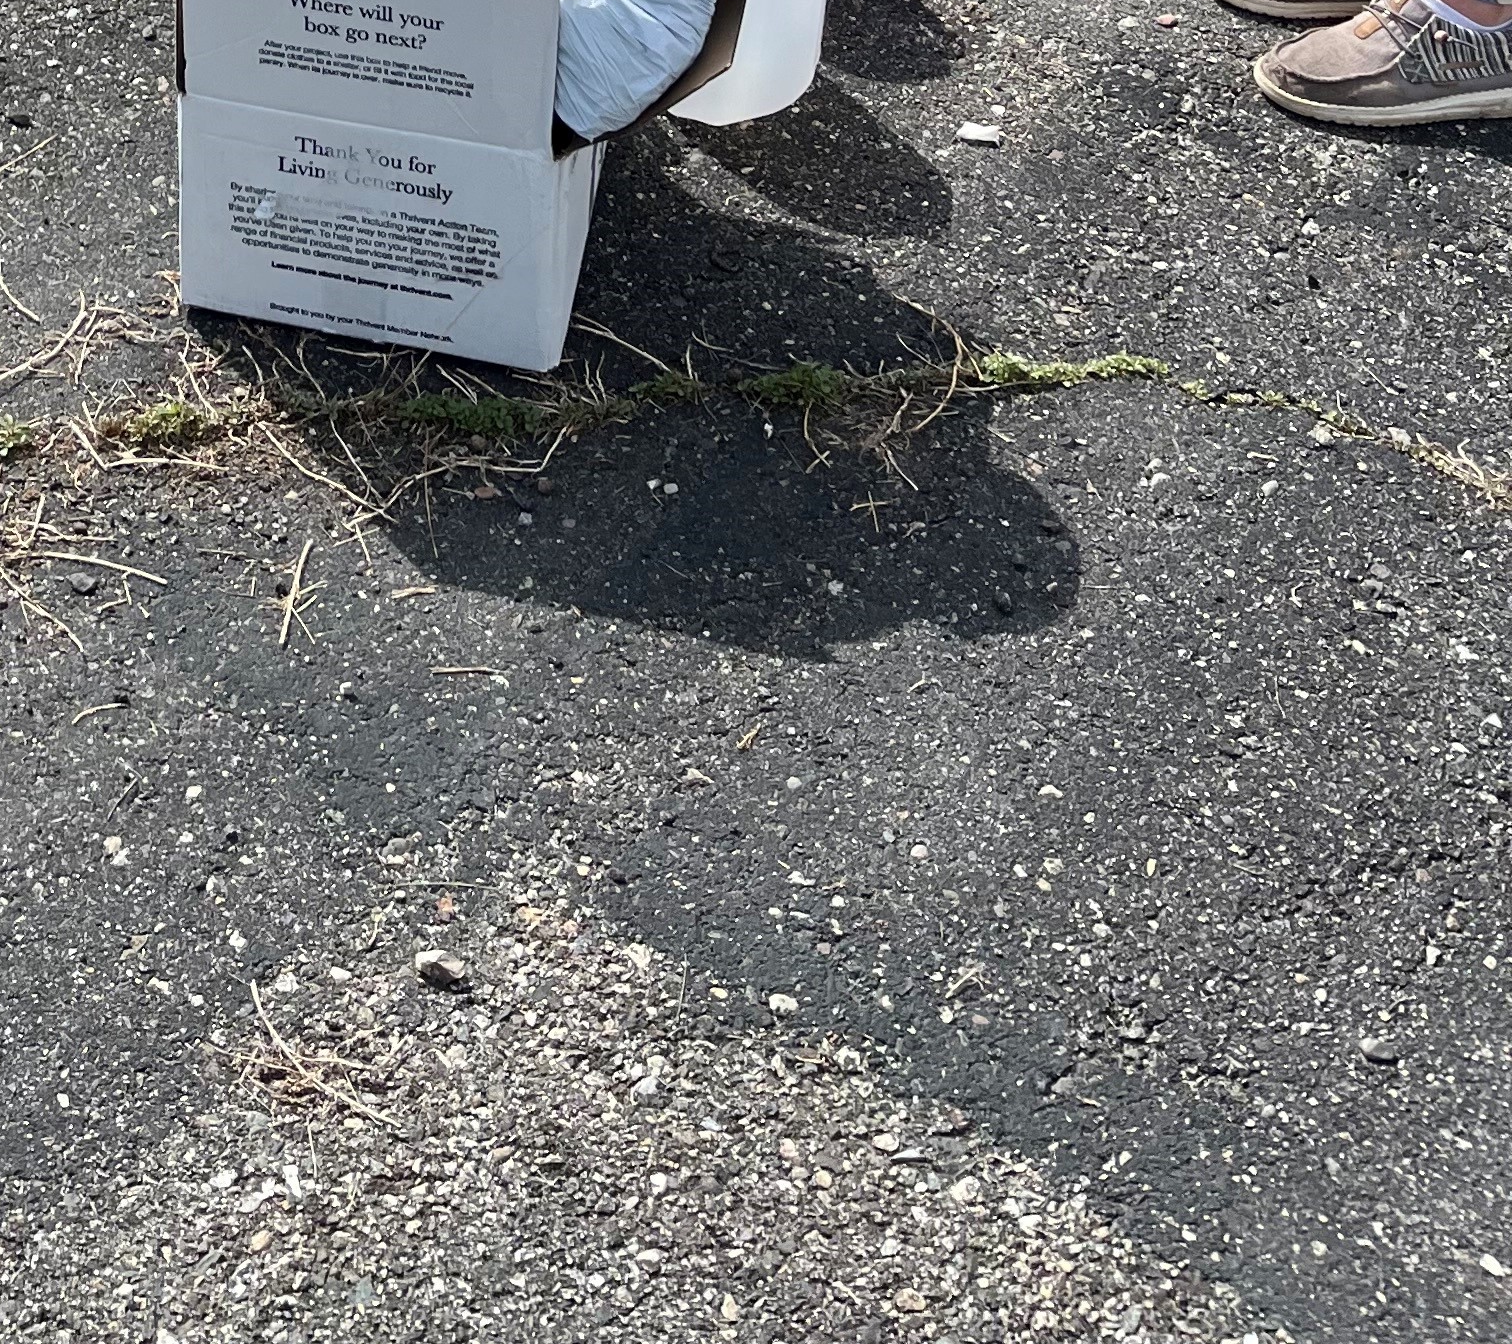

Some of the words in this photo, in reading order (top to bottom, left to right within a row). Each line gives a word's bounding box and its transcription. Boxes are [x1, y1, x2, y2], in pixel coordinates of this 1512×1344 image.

[304, 16, 340, 37] box
[345, 27, 369, 44] go
[375, 34, 427, 50] next?
[359, 4, 394, 23] will
[399, 12, 445, 31] your
[294, 136, 360, 162] Thank
[366, 147, 402, 170] You
[408, 155, 437, 175] for
[231, 182, 242, 192] By
[277, 155, 338, 185] Living
[344, 169, 453, 205] Generously
[229, 203, 244, 212] this
[233, 195, 255, 204] you'll
[233, 215, 262, 226] you've
[289, 225, 316, 235] given.
[320, 229, 331, 238] To
[333, 232, 353, 243] help
[356, 237, 372, 245] you
[388, 243, 407, 252] your
[411, 246, 447, 260] journey,
[450, 254, 463, 262] we
[465, 257, 486, 266] offer
[301, 217, 318, 226] well
[320, 220, 332, 228] on
[334, 223, 354, 232] your
[357, 227, 374, 237] way
[378, 229, 386, 238] to
[388, 233, 422, 246] making
[425, 238, 439, 247] the
[441, 242, 464, 252] most
[466, 246, 476, 254] of
[478, 249, 500, 258] what
[362, 216, 403, 232] including
[406, 225, 427, 234] your
[429, 229, 450, 239] own.
[453, 233, 466, 243] By
[468, 235, 496, 248] taking
[400, 212, 436, 225] Thrivent
[438, 219, 468, 231] Action
[470, 225, 499, 237] Team,
[230, 225, 257, 236] range
[259, 230, 269, 238] of
[270, 231, 308, 245] financial
[310, 239, 352, 253] products,
[355, 247, 393, 260] services
[395, 255, 413, 264] and
[415, 258, 448, 271] advice,
[465, 267, 483, 276] well
[242, 238, 300, 253] opportunities
[302, 247, 311, 255] to
[313, 249, 369, 266] demonstrate
[372, 261, 419, 277] generosity
[422, 269, 430, 277] in
[432, 272, 456, 282] more
[272, 260, 294, 271] Learn
[296, 266, 317, 275] more
[318, 270, 341, 280] about
[343, 274, 356, 283] the
[358, 276, 388, 290] journey
[270, 302, 300, 315] Brought
[301, 308, 308, 316] to
[310, 311, 324, 319] you
[326, 313, 334, 323] by
[337, 316, 353, 324] your
[356, 318, 385, 331] Thrivent
[387, 324, 418, 337] Member
